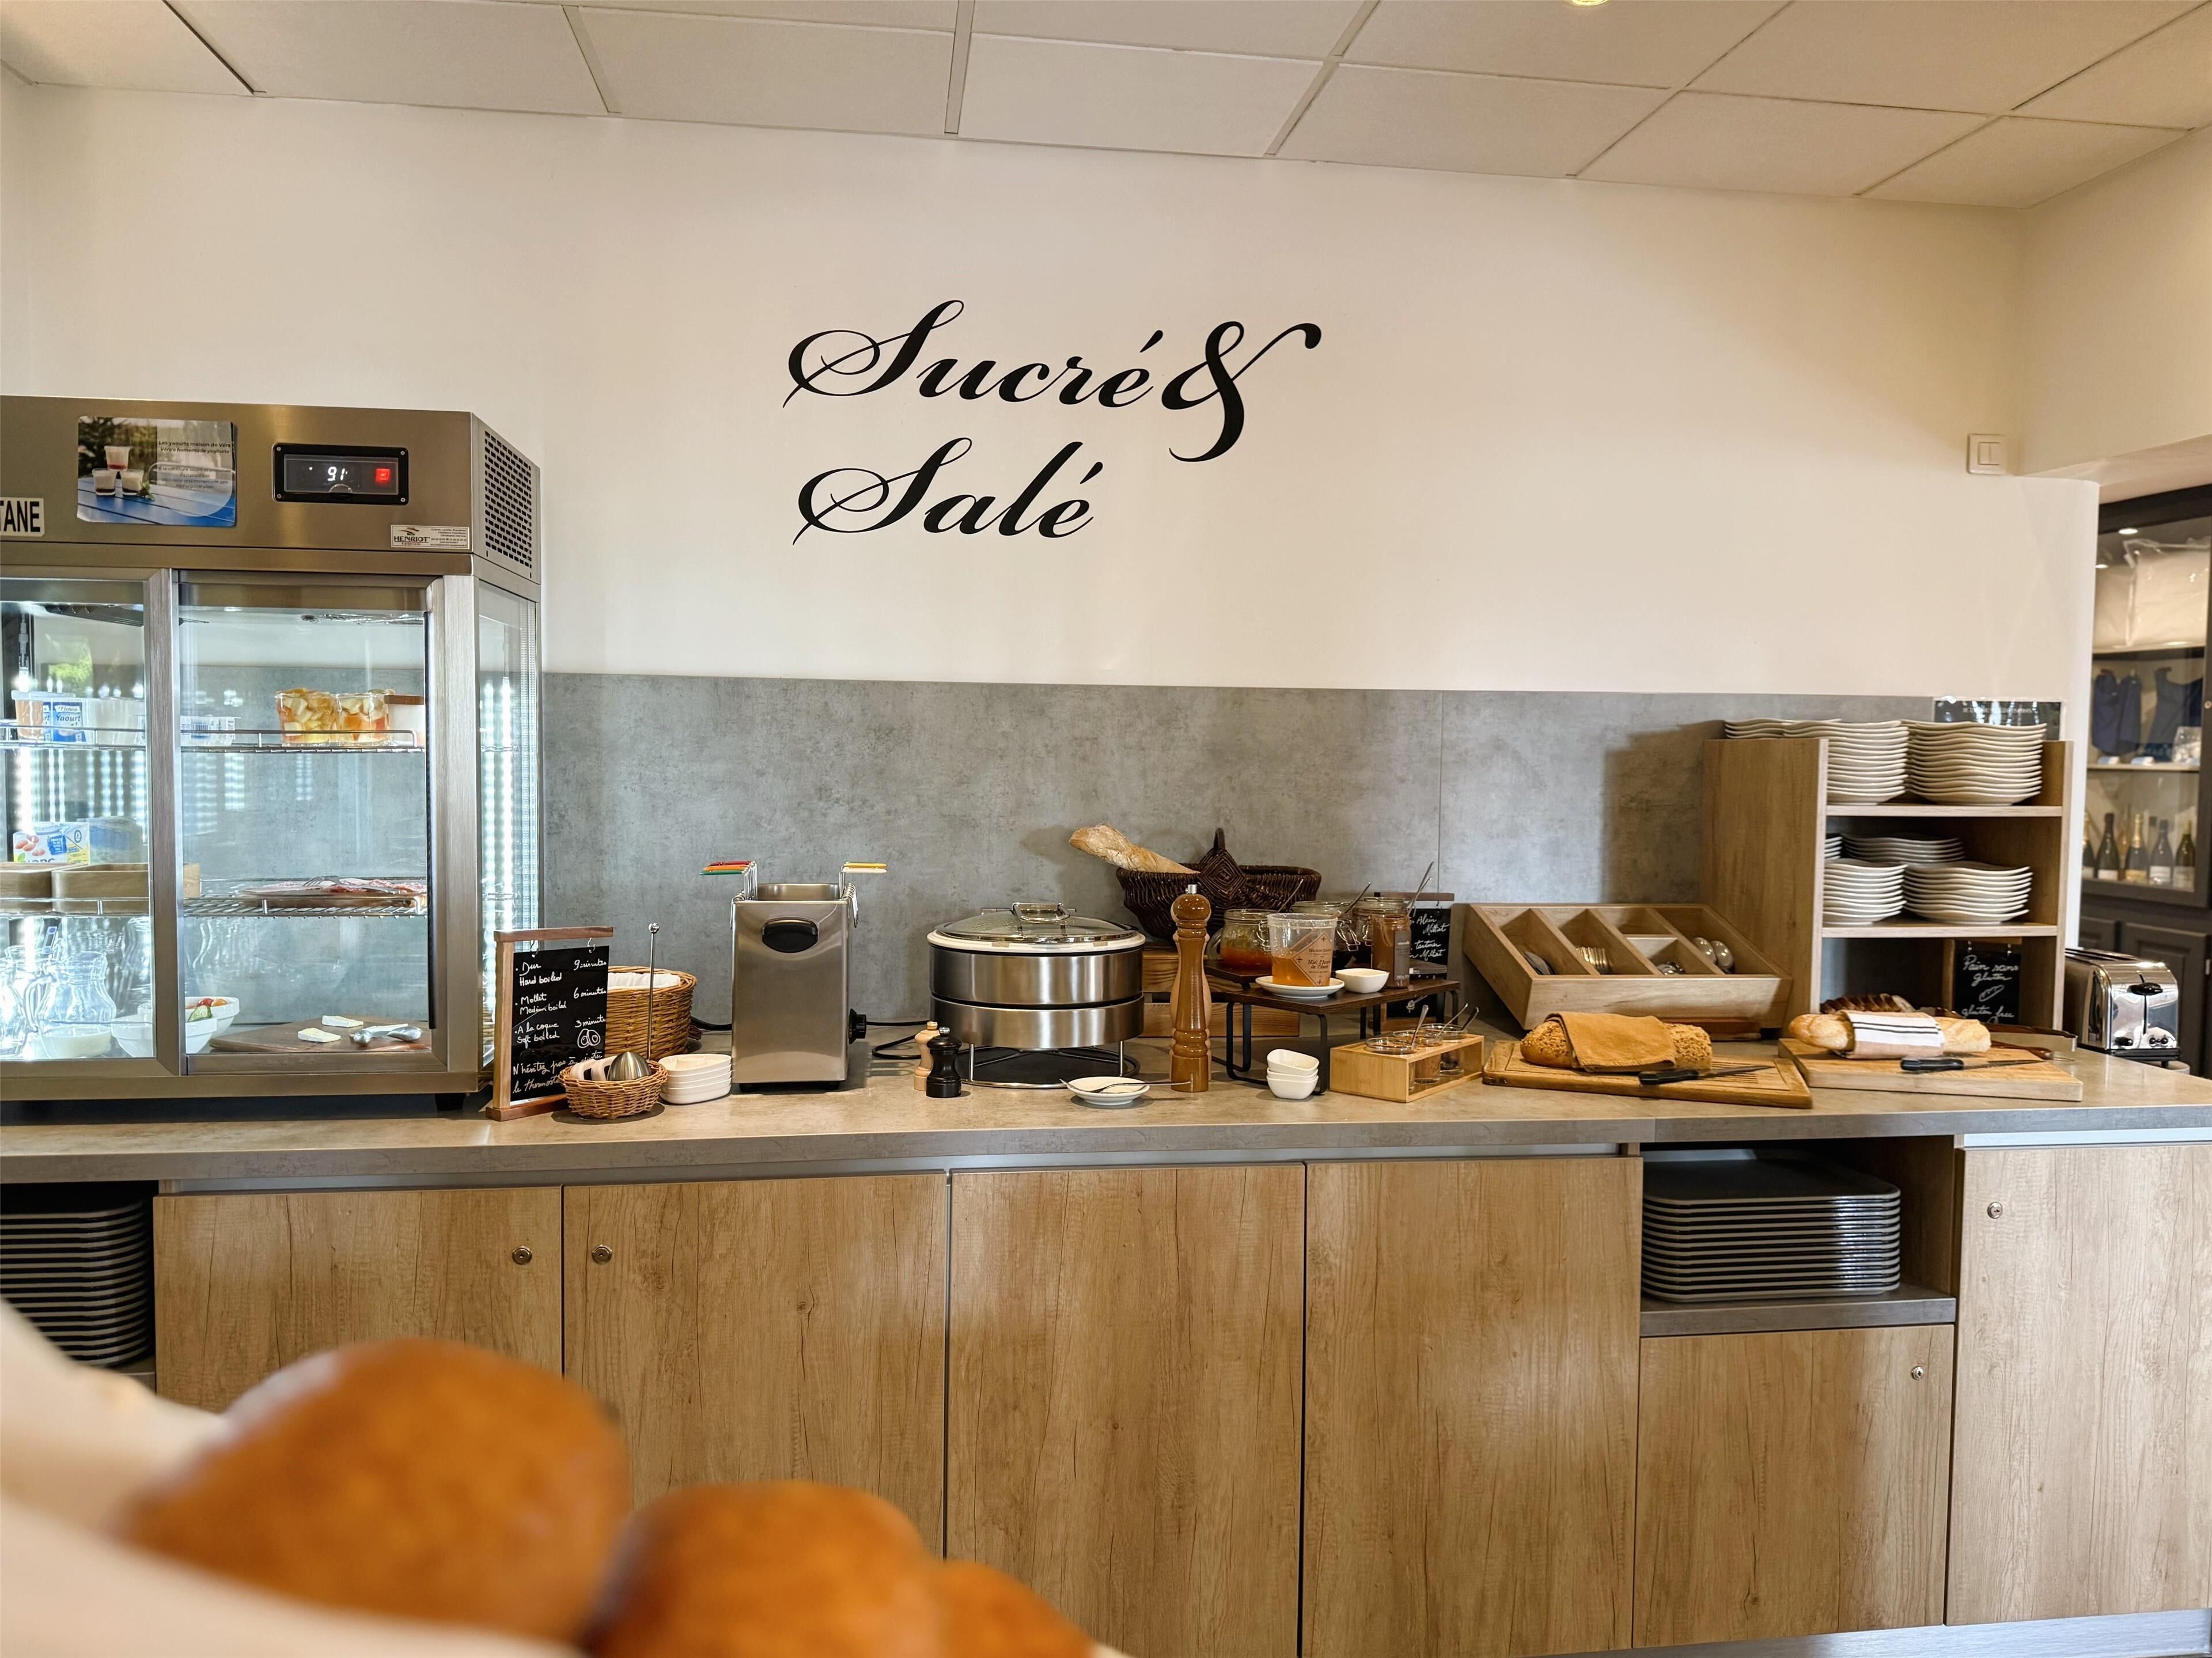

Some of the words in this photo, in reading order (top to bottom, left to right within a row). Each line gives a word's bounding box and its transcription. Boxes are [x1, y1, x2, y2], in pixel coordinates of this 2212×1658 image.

[783, 299, 1164, 408] Sucré
[1161, 321, 1322, 462] &
[793, 437, 1104, 545] Salé
[519, 962, 541, 976] Dur
[573, 959, 581, 971] 9
[1963, 954, 1990, 971] Pain
[1991, 964, 2019, 972] sans
[520, 976, 536, 987] Hard
[539, 971, 562, 984] boiled
[1971, 972, 2012, 987] gluten
[520, 992, 547, 1005] Mollet
[573, 987, 579, 999] 6
[581, 987, 607, 997] minutes
[520, 1005, 547, 1015] Medium
[548, 1000, 567, 1011] boiled
[517, 1025, 524, 1034] A
[525, 1022, 535, 1033] la
[536, 1022, 559, 1035] coque
[575, 1020, 582, 1028] 3
[516, 1035, 532, 1049] Soft
[533, 1030, 560, 1042] boiled
[550, 1060, 566, 1074] pas
[513, 1080, 522, 1094] le
